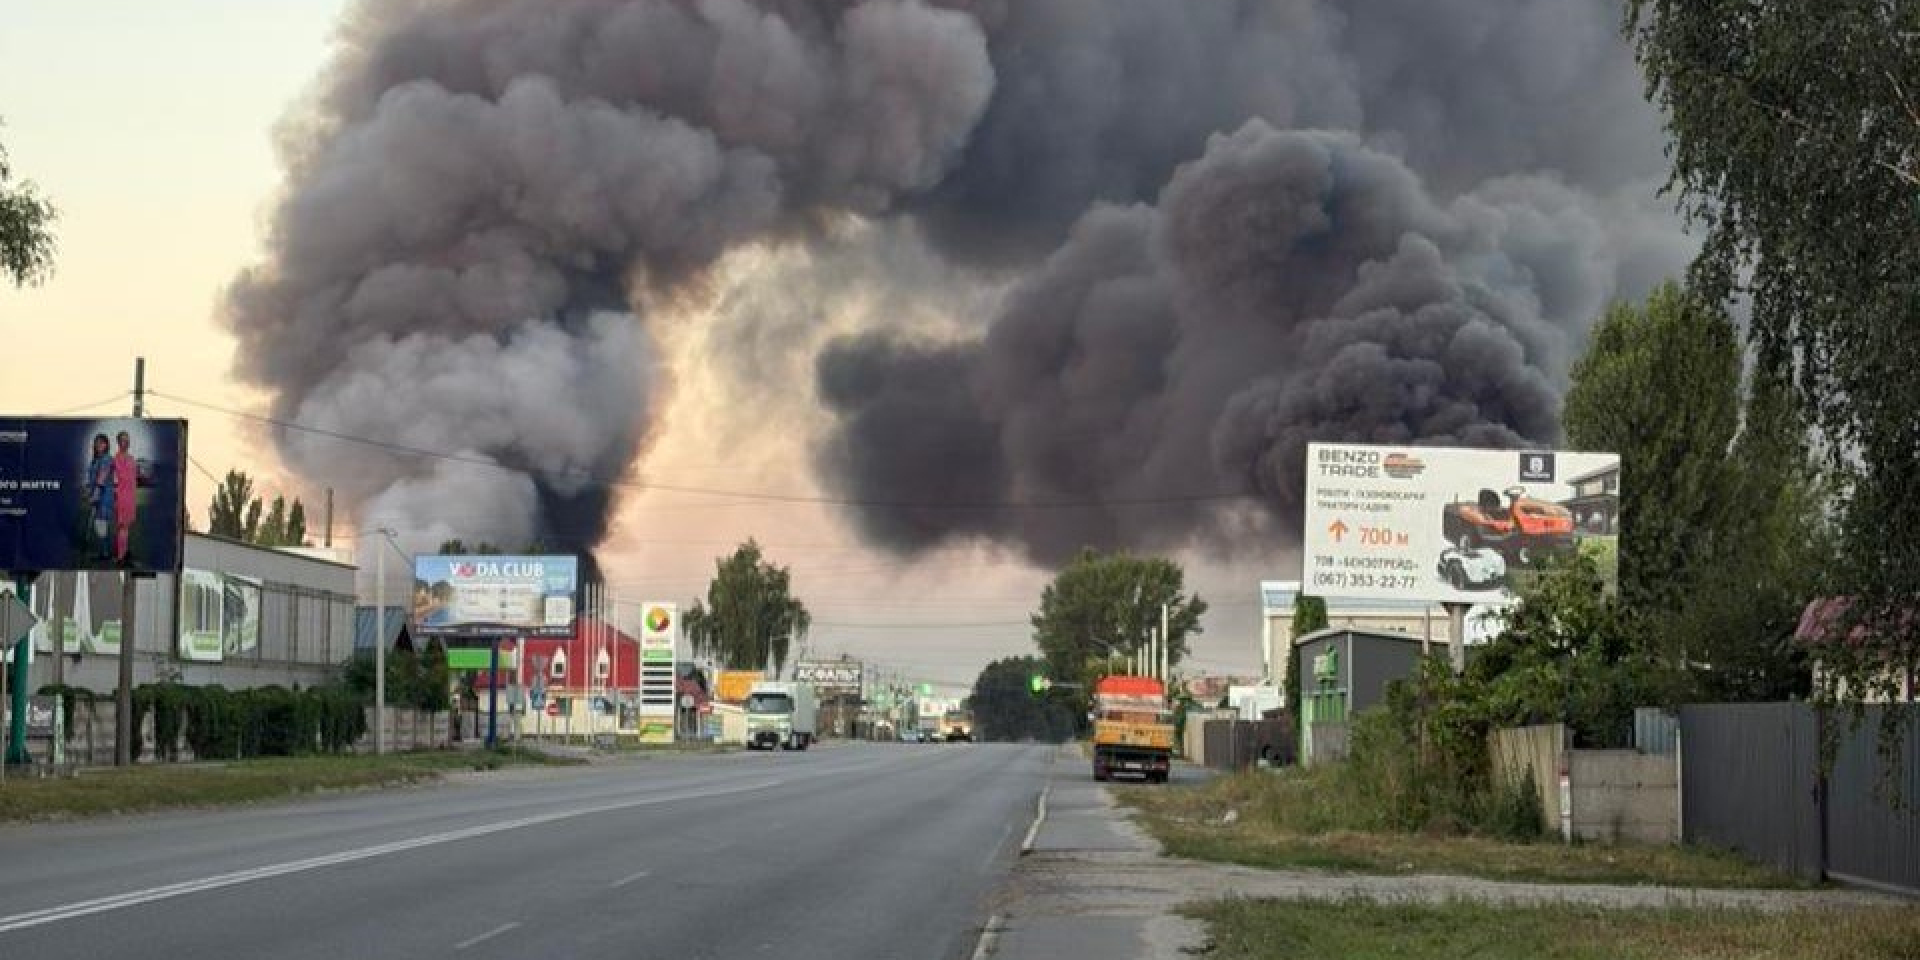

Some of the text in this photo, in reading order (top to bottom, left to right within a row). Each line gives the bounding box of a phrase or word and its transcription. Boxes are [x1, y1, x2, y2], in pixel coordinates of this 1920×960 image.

[1318, 449, 1380, 463] BENZO
[1318, 463, 1380, 478] TRADE
[1358, 527, 1393, 545] 700
[503, 561, 544, 577] CLUB
